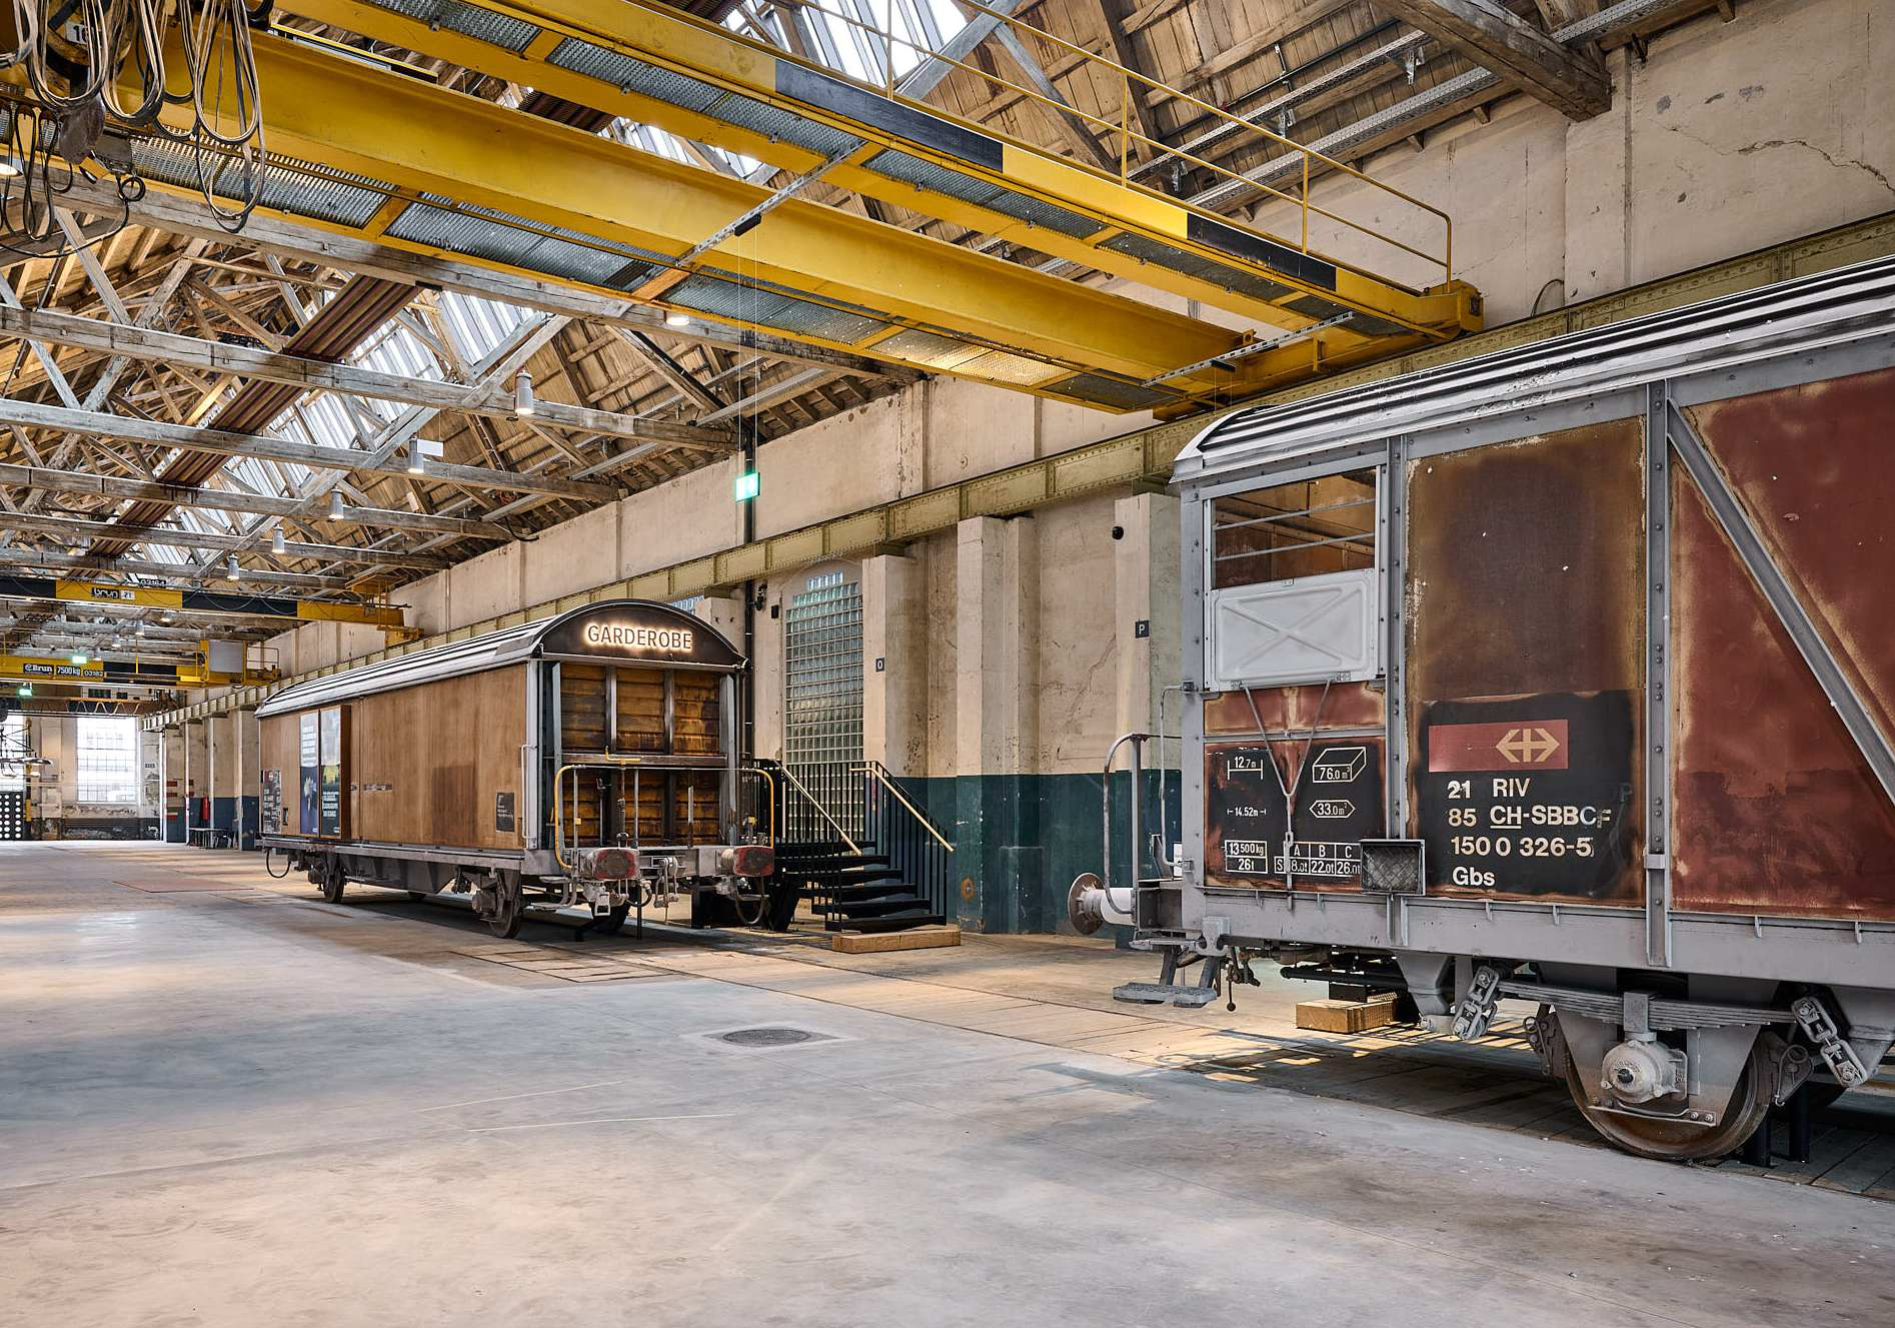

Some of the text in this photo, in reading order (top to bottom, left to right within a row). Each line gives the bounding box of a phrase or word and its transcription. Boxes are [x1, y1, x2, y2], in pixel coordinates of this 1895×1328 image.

[586, 624, 693, 651] GARDEROBE
[1138, 623, 1146, 636] P
[32, 664, 53, 673] Brun
[1447, 778, 1531, 799] 21 RIV
[1448, 808, 1477, 827] 85
[1293, 844, 1352, 859] A B C
[1277, 859, 1283, 871] S
[1452, 866, 1496, 887] Gbs
